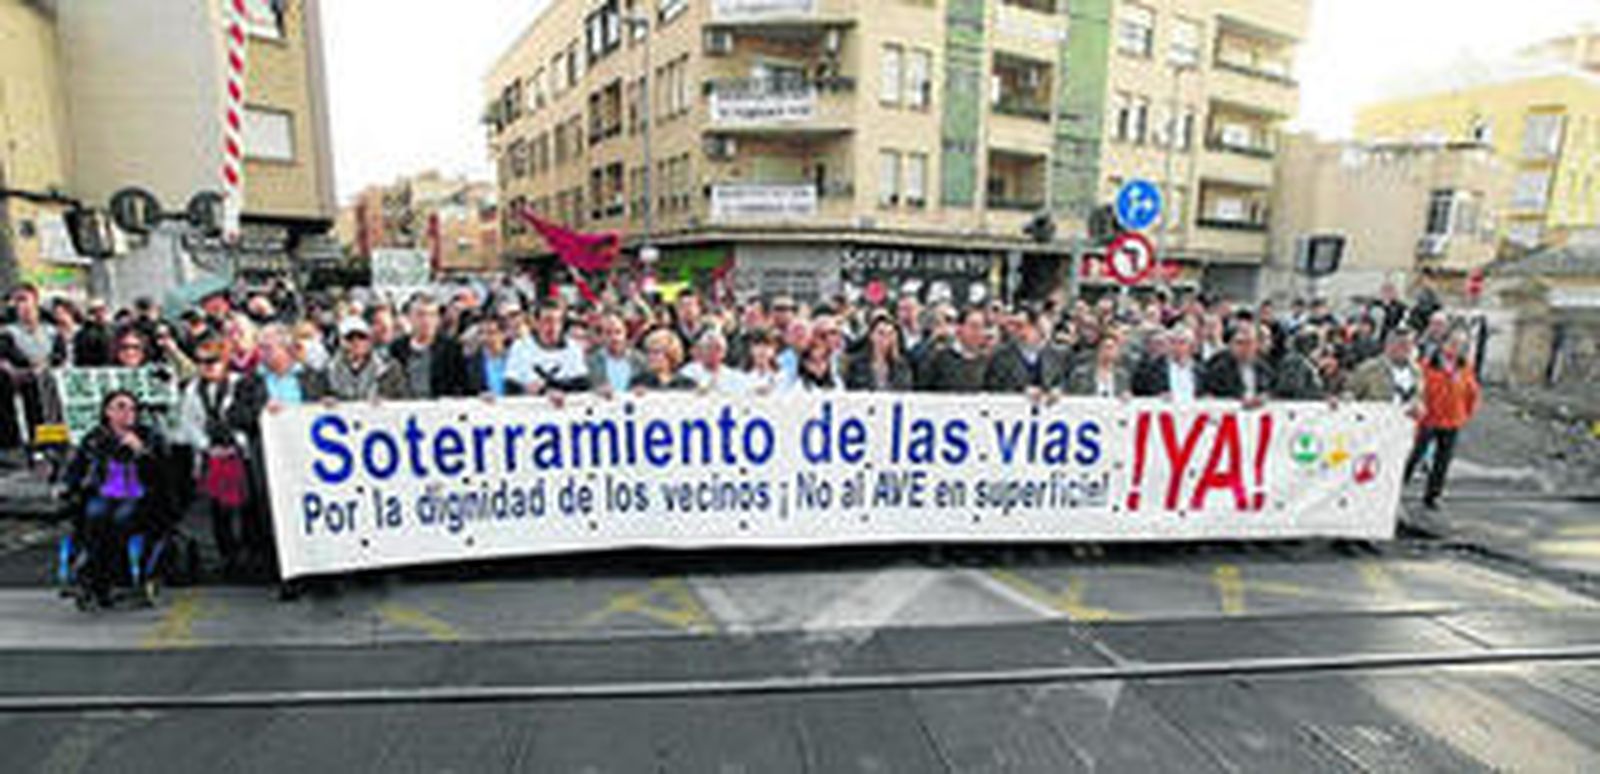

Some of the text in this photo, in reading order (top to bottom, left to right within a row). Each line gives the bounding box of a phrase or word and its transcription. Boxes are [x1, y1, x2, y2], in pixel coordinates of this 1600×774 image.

[309, 402, 777, 483] Soterramiento
[799, 401, 868, 465] de
[889, 401, 970, 466] las
[301, 491, 358, 536] Por
[373, 488, 402, 529] la
[415, 477, 546, 534] dignidad
[556, 476, 594, 515] de
[604, 474, 651, 513] los
[659, 473, 772, 513] vecinos
[840, 470, 865, 509] al
[871, 470, 926, 508] AVE
[934, 479, 967, 508] en
